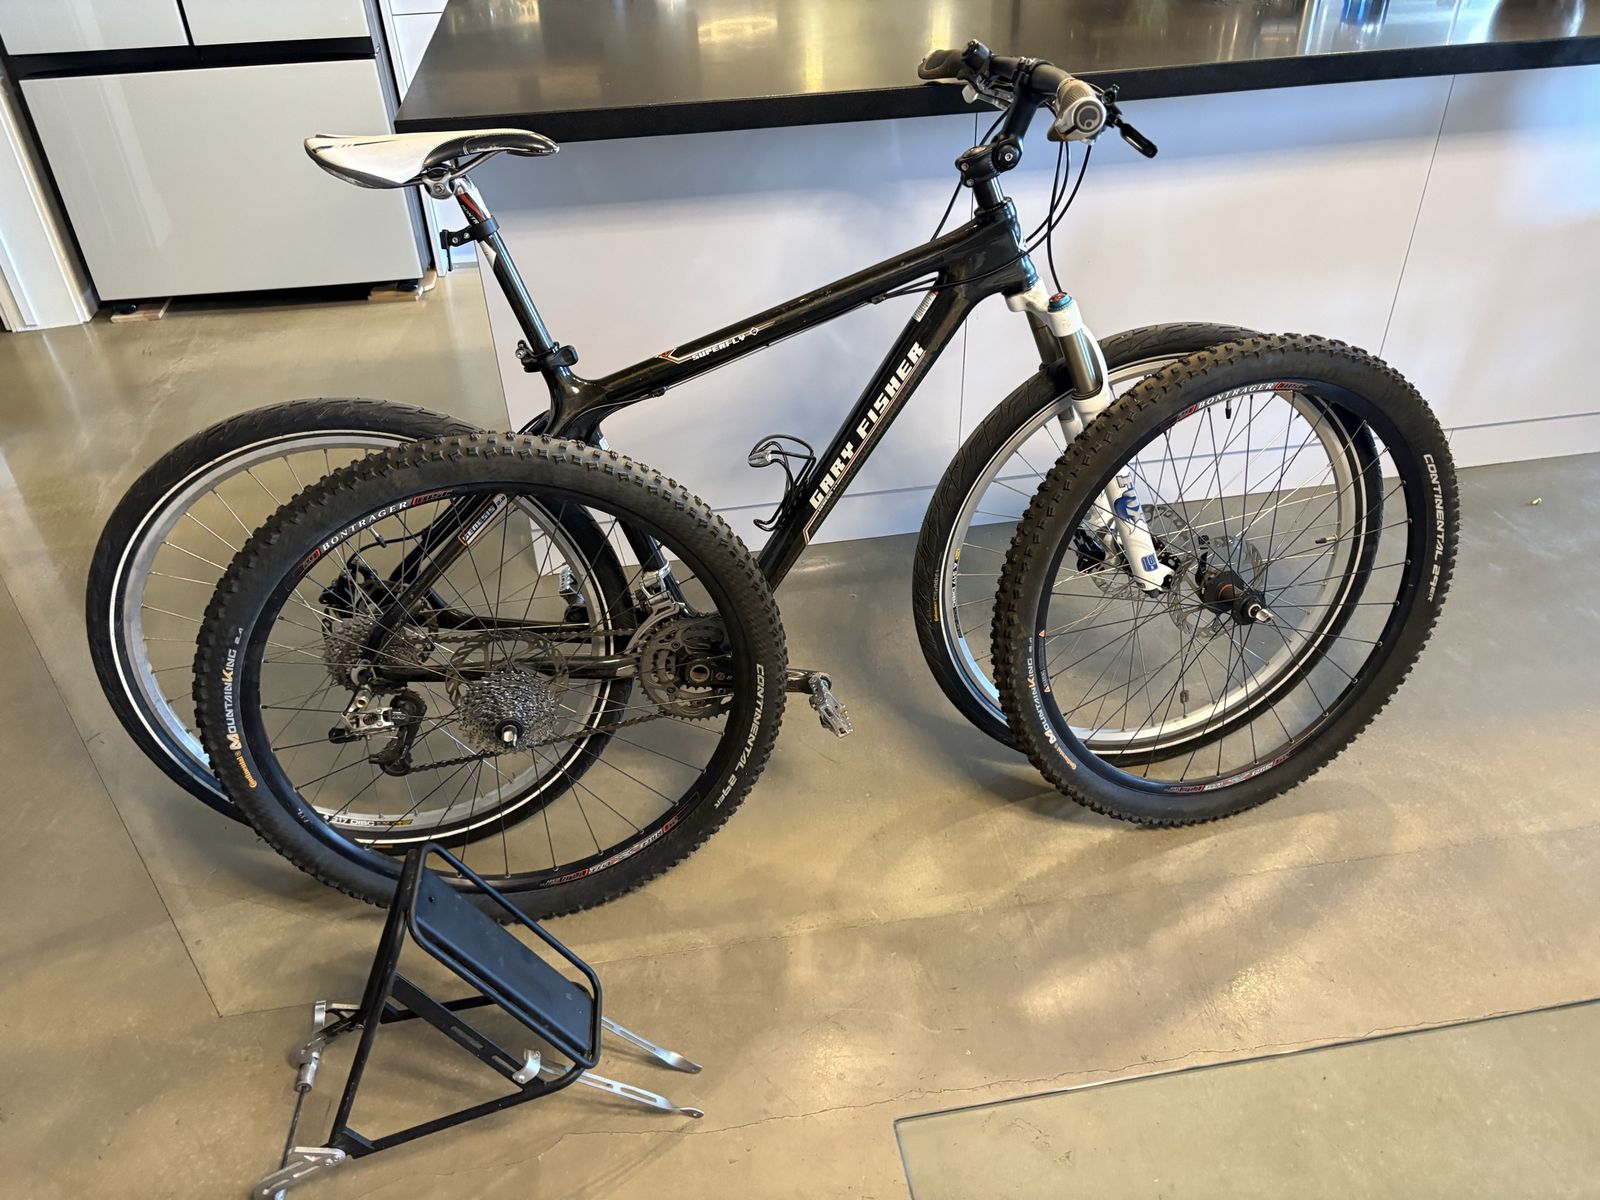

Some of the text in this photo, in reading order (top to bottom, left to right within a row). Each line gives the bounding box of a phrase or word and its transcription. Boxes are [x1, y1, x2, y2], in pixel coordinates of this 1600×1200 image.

[692, 335, 746, 360] SUPERFLY
[1197, 382, 1275, 411] BONTRAGER
[809, 441, 855, 510] GARY
[856, 342, 926, 440] FISHER
[322, 500, 409, 551] BONTRAGER
[463, 504, 496, 543] GENESIS
[1423, 453, 1445, 562] CONTINENTAL
[734, 663, 765, 773] CONTINENTAL
